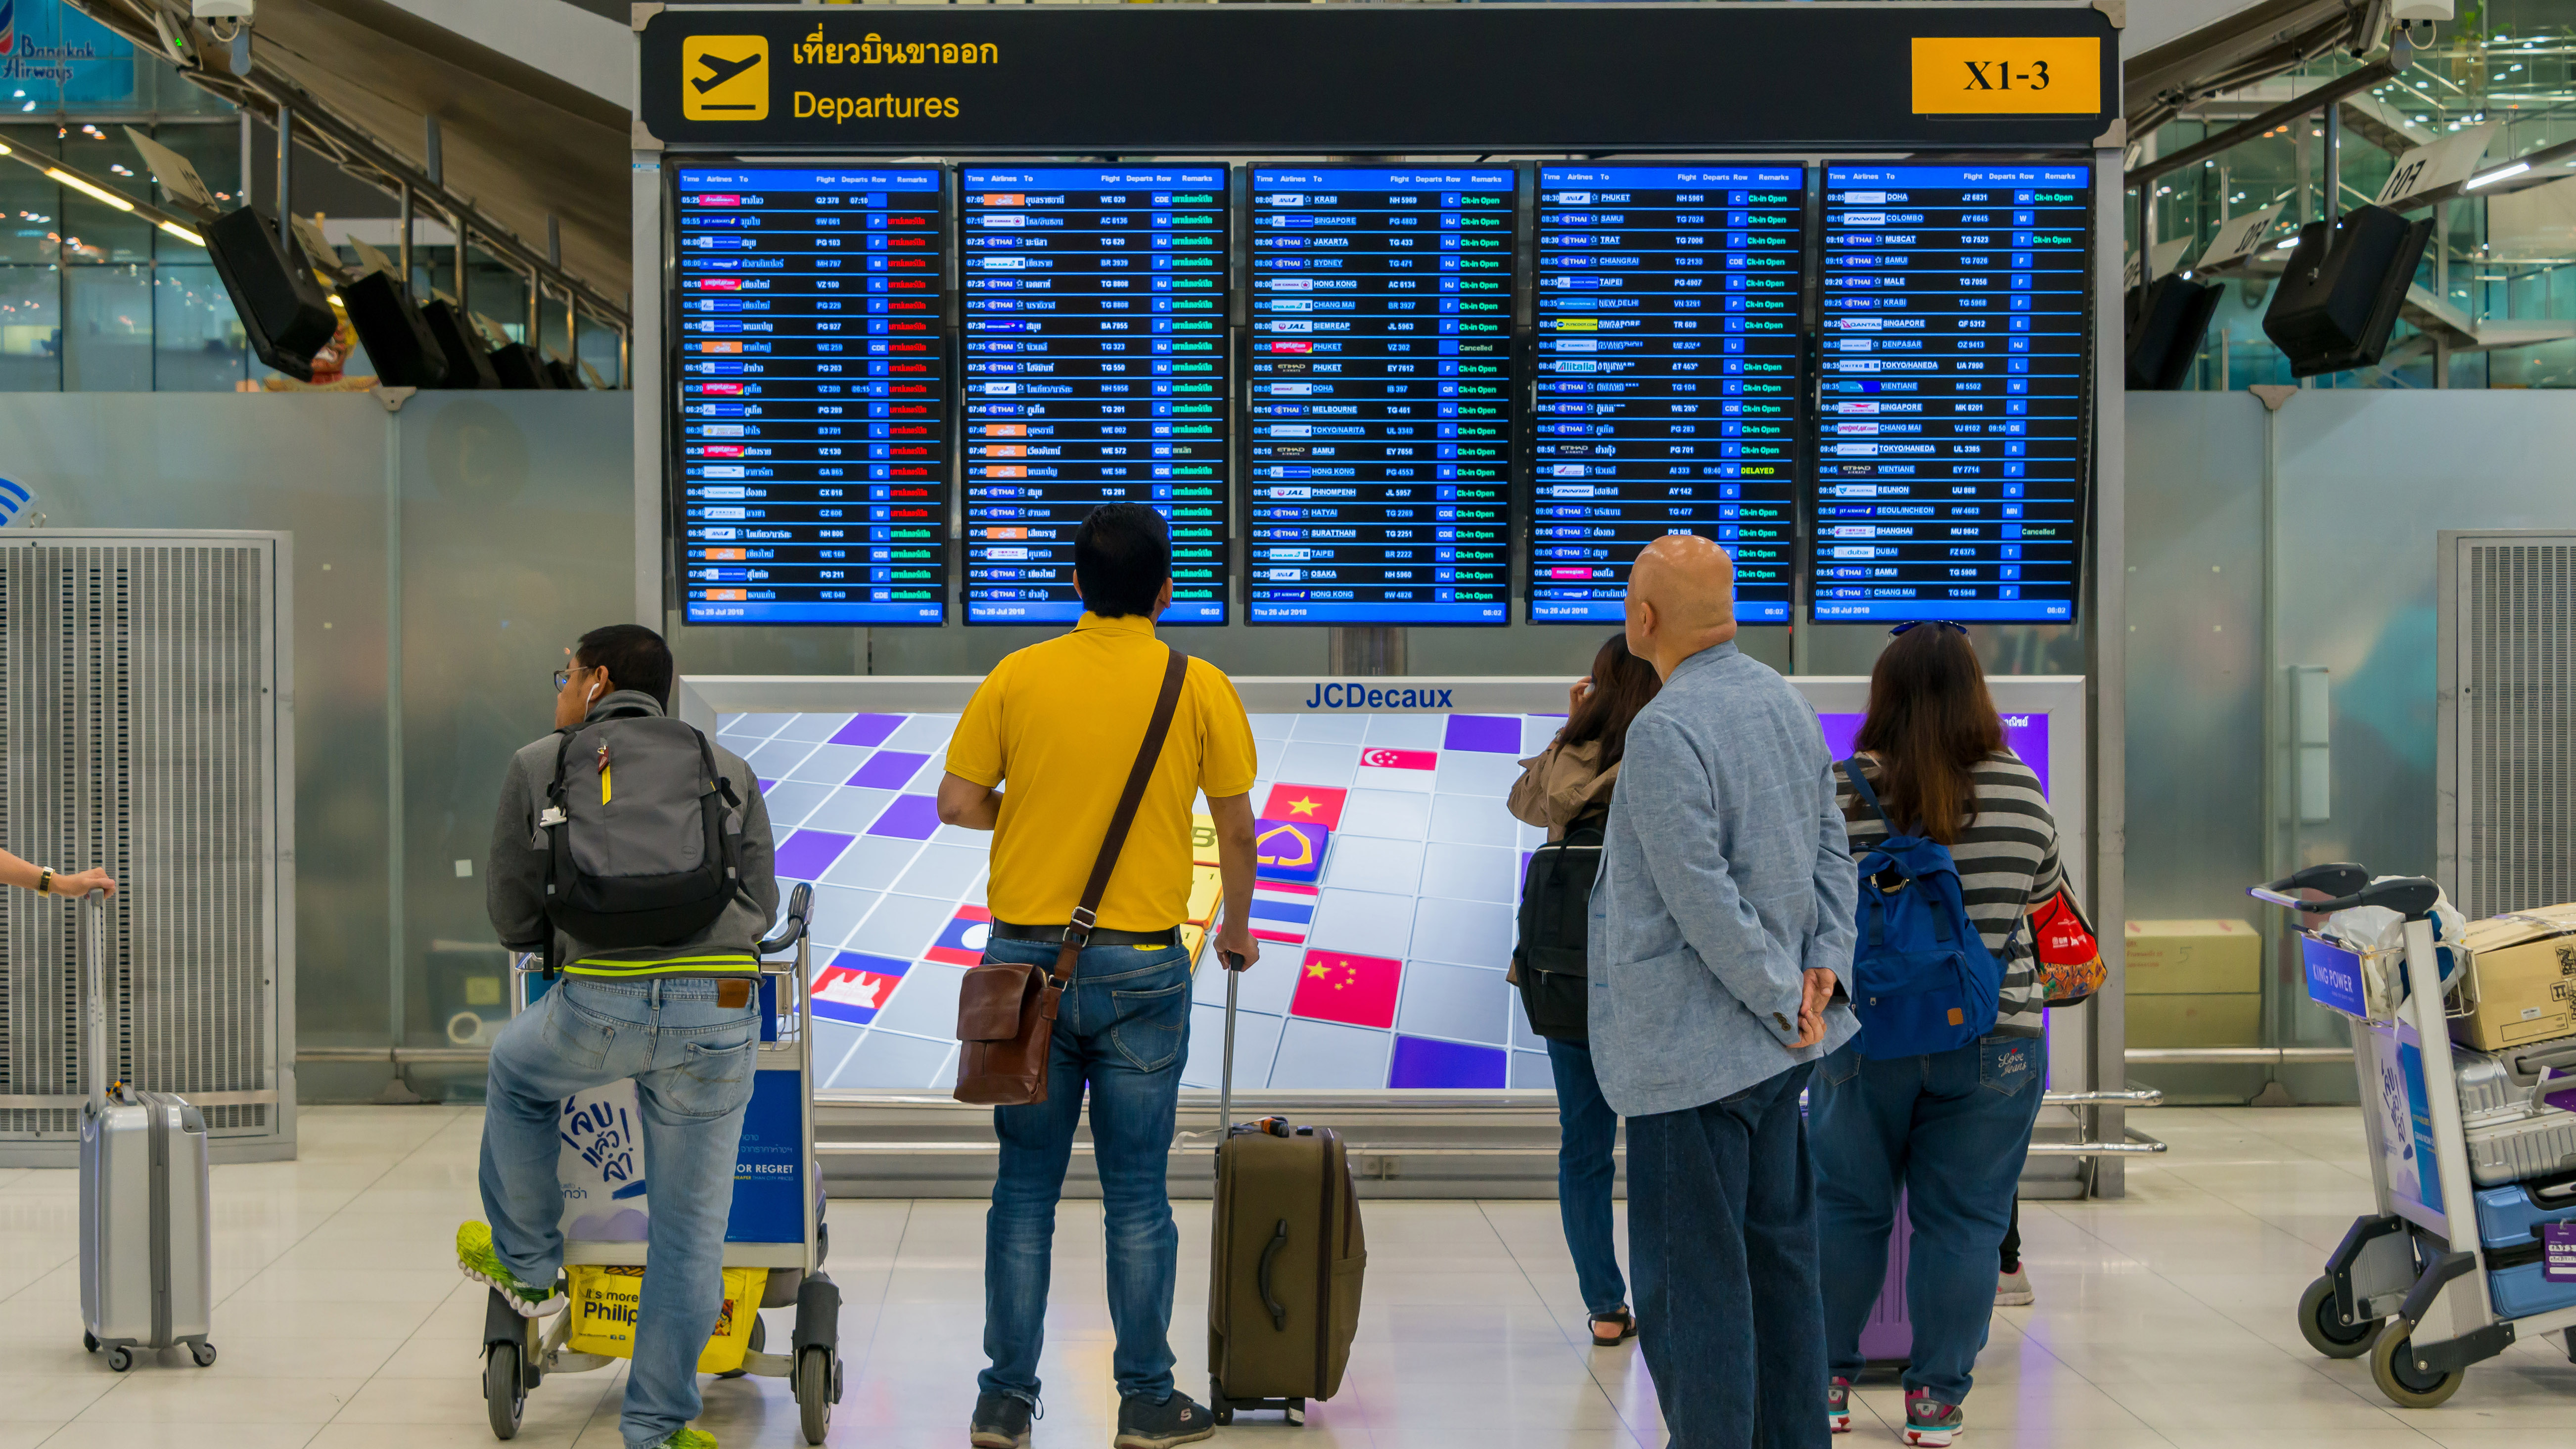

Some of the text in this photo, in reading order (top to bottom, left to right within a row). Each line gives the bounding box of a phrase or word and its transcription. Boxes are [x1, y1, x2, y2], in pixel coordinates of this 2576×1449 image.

[21, 33, 95, 60] Bangkok
[793, 24, 998, 64] เที่ยวบินขาออก
[1, 57, 74, 87] Airways
[1963, 60, 2050, 91] X1-3
[793, 91, 960, 125] Departures
[1963, 173, 1983, 181] Flight
[1480, 239, 1499, 248] Open
[1766, 237, 1786, 246] Open
[2052, 235, 2071, 245] Open
[1558, 361, 1596, 371] Alitalia
[1478, 407, 1496, 415] Open
[1477, 490, 1495, 498] Open
[1306, 682, 1453, 709] JCDecaux
[2312, 963, 2353, 993] KING POWER
[1998, 1052, 2024, 1068] Love
[2000, 1061, 2026, 1078] Jeans
[736, 1164, 793, 1174] OR REGRET
[606, 1292, 639, 1302] more
